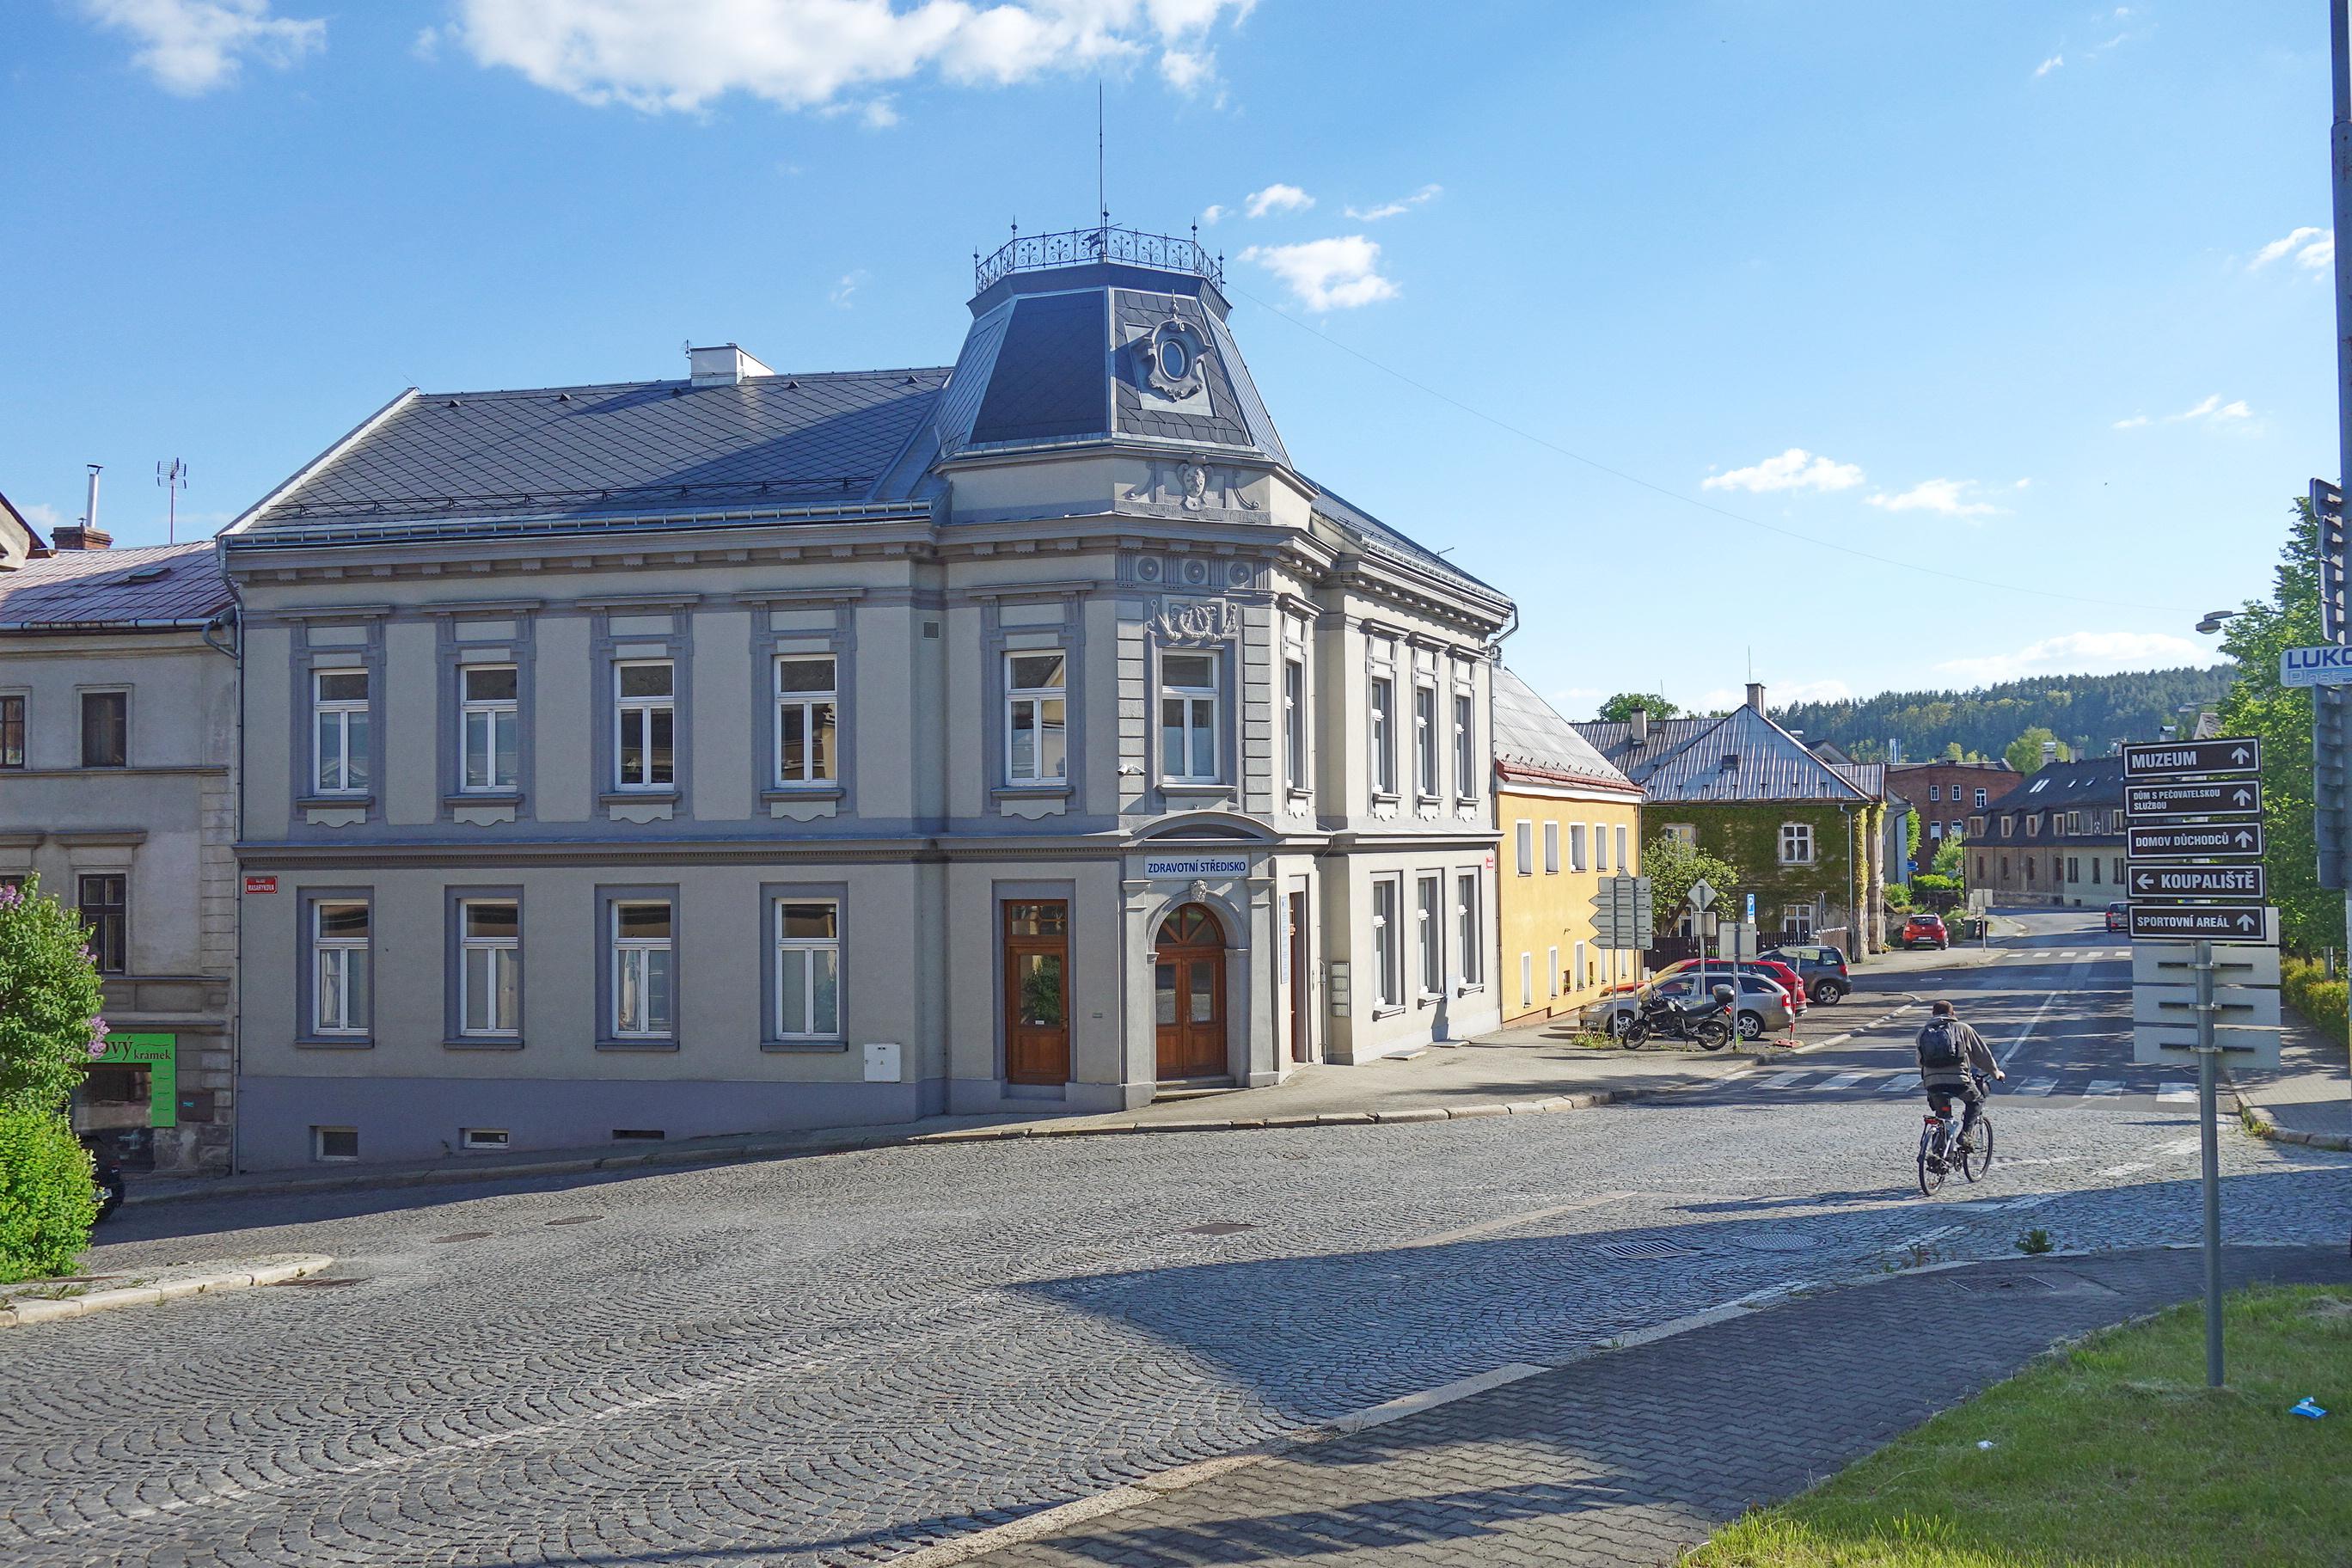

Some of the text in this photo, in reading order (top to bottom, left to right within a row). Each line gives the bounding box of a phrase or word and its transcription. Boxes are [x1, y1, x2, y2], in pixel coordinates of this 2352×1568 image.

[2132, 751, 2197, 769] MUZEUM
[2134, 790, 2150, 800] DŮM
[2159, 788, 2220, 799] PEČOVATELSKOU
[2134, 801, 2167, 811] SLUŽBOU
[2135, 832, 2229, 847] DOMOV DŮCHODCŮ
[1148, 859, 1246, 873] ZDRAVOTNÍ STŘEDISKO
[2161, 871, 2255, 889] KOUPALIŠTĚ
[2137, 915, 2230, 928] SPORTOVNÍ AREÁL
